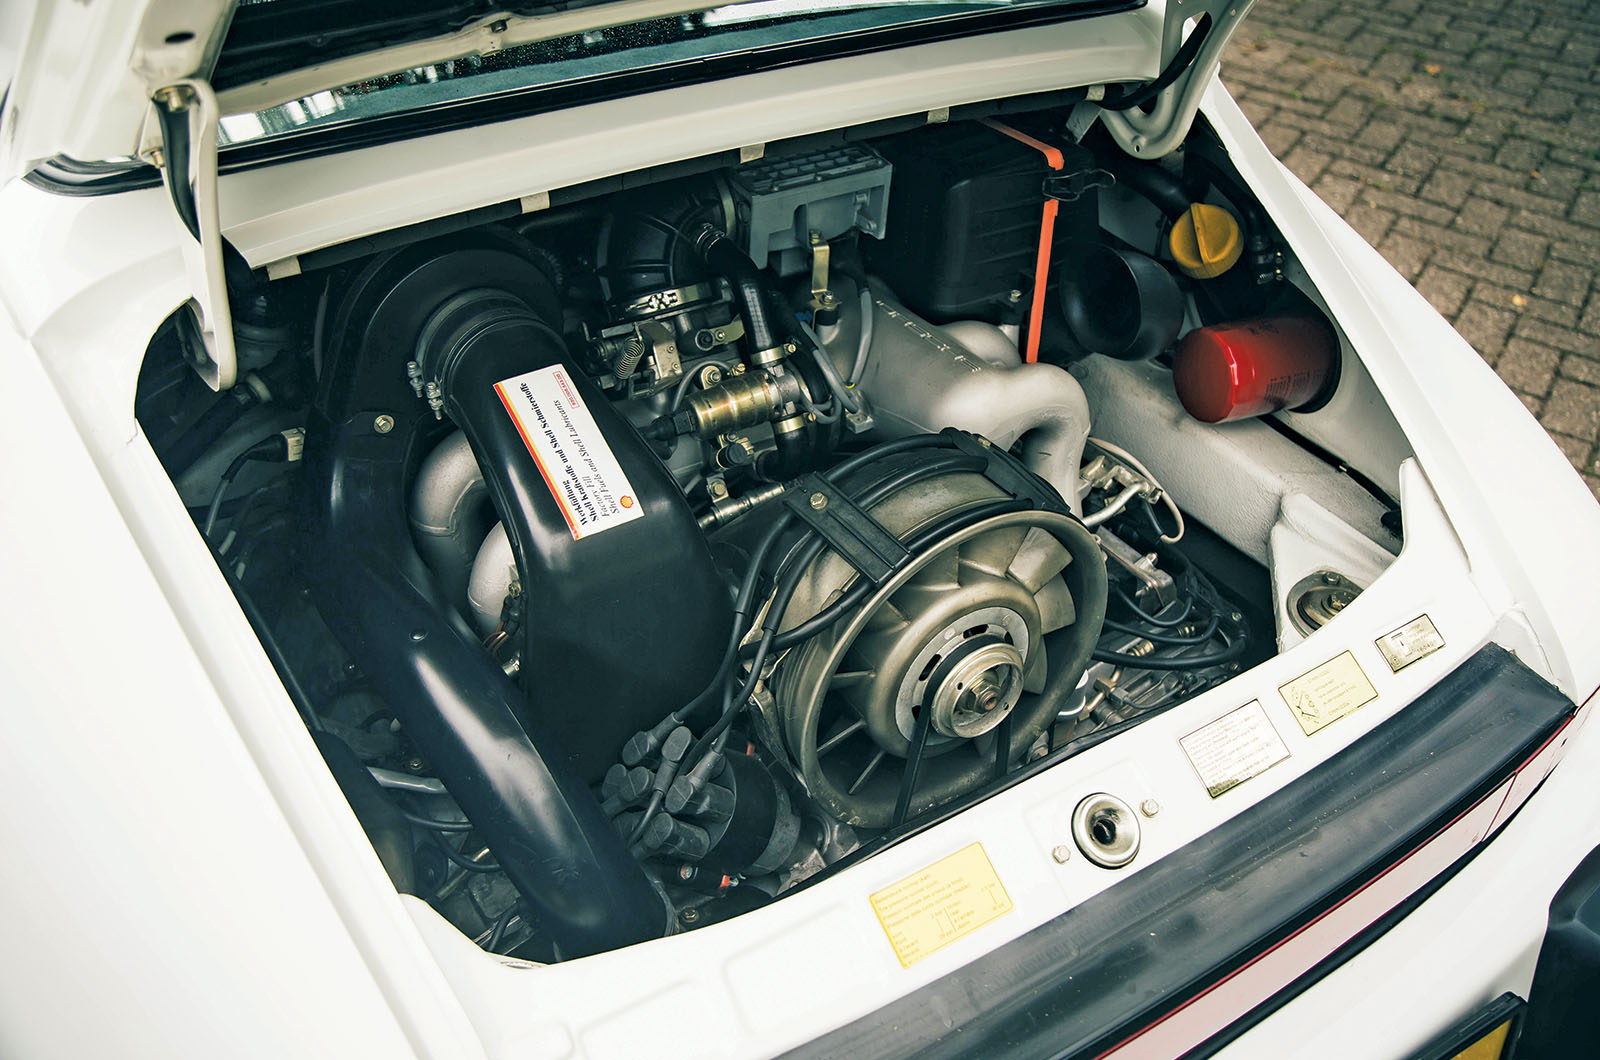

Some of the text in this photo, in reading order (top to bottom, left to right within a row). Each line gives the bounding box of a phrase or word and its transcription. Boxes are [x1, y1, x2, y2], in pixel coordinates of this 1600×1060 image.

[519, 382, 599, 522] Shell Kraftstoffe und Shell Schmierstoffe
[553, 399, 620, 514] Shell Fuels and Shell Lubricants
[562, 480, 588, 525] Werkfüllung
[582, 475, 610, 516] Factory Fill
